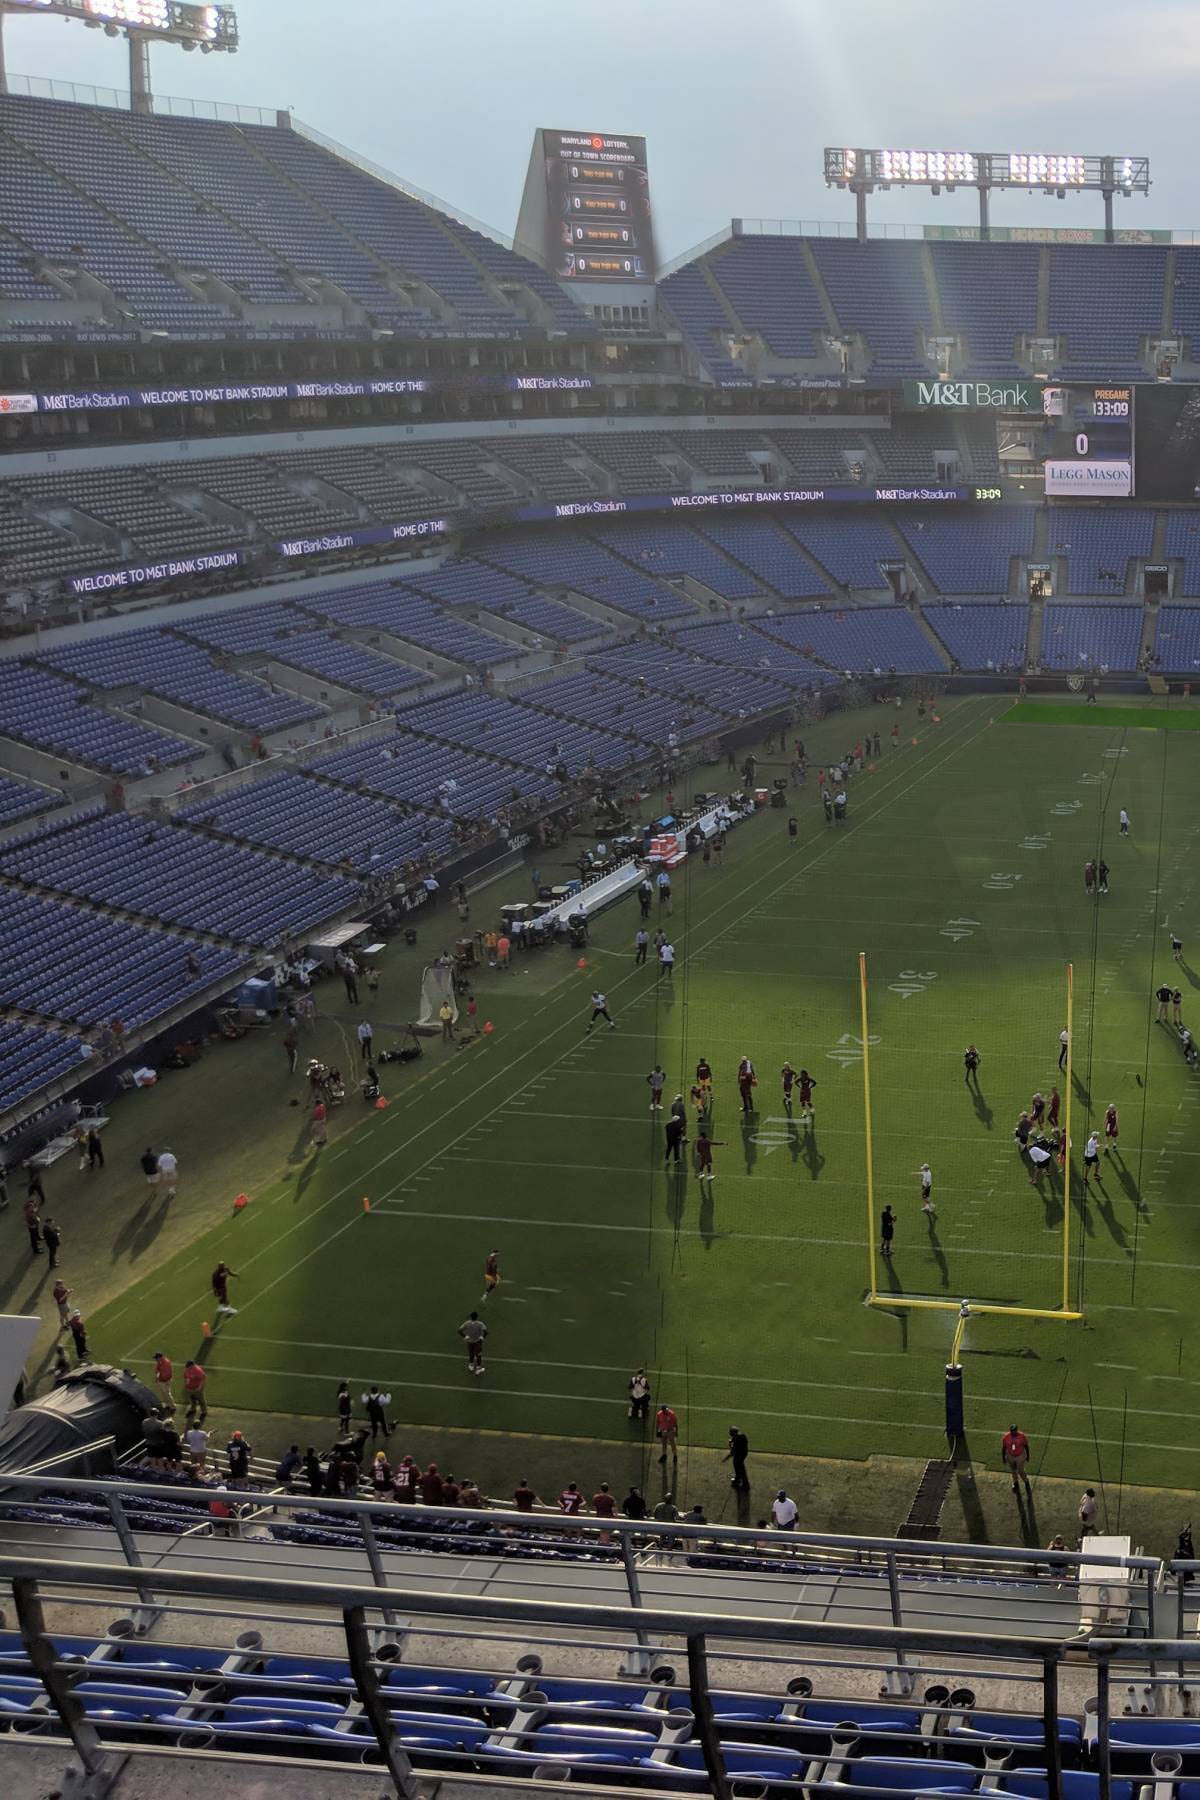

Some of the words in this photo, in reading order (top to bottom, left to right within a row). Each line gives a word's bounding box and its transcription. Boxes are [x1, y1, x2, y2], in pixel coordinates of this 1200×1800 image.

[561, 137, 592, 146] MARYLAND
[560, 150, 572, 158] OUT
[573, 151, 582, 159] OF
[582, 152, 599, 160] TOWN
[600, 153, 635, 161] SCOREBOARD
[297, 384, 316, 396] M&T
[316, 384, 335, 396] Bank
[335, 383, 364, 396] Stadium
[371, 382, 395, 393] HOME
[395, 381, 407, 392] OF
[407, 381, 423, 391] THE
[517, 378, 538, 389] M&T
[538, 378, 558, 389] Bank
[559, 377, 592, 389] Stadium
[43, 394, 68, 409] M&T
[68, 394, 91, 408] Bank
[92, 393, 130, 408] Stadium
[141, 390, 188, 404] WELCOME
[190, 389, 204, 402] TO
[204, 389, 224, 401] M&T
[226, 387, 250, 400] BANK
[251, 386, 288, 399] STADIUM
[917, 382, 974, 405] M&T
[976, 383, 1029, 406] Bank
[1094, 389, 1130, 400] PREGAME
[1076, 433, 1088, 455] 0
[1051, 468, 1083, 480] LEGG
[1086, 467, 1129, 480] MASON
[672, 495, 719, 507] WELCOME
[720, 494, 732, 503] TO
[734, 493, 754, 502] M&T
[756, 492, 782, 502] BANK
[783, 491, 824, 501] STADIUM
[876, 489, 899, 500] M&T
[899, 489, 920, 499] Bank
[920, 489, 957, 499] Stadium
[976, 489, 1001, 499] 33:09
[556, 504, 575, 517] M&T
[575, 502, 594, 515] Bank
[594, 501, 626, 513] Stadium
[393, 524, 417, 538] HOME
[417, 522, 429, 534] OF
[282, 541, 303, 556] M&T
[303, 539, 322, 554] Bank
[322, 535, 353, 550] Stadium
[73, 571, 128, 593] WELCOME
[128, 568, 145, 583] TO
[146, 564, 168, 580] M&T
[169, 559, 196, 576] BANK
[197, 552, 238, 570] STADIUM
[982, 872, 1023, 889] 50
[939, 917, 982, 936] 40
[888, 970, 938, 993] 30
[826, 1033, 883, 1060] 20
[396, 1472, 410, 1486] 21
[563, 1500, 574, 1512] 7
